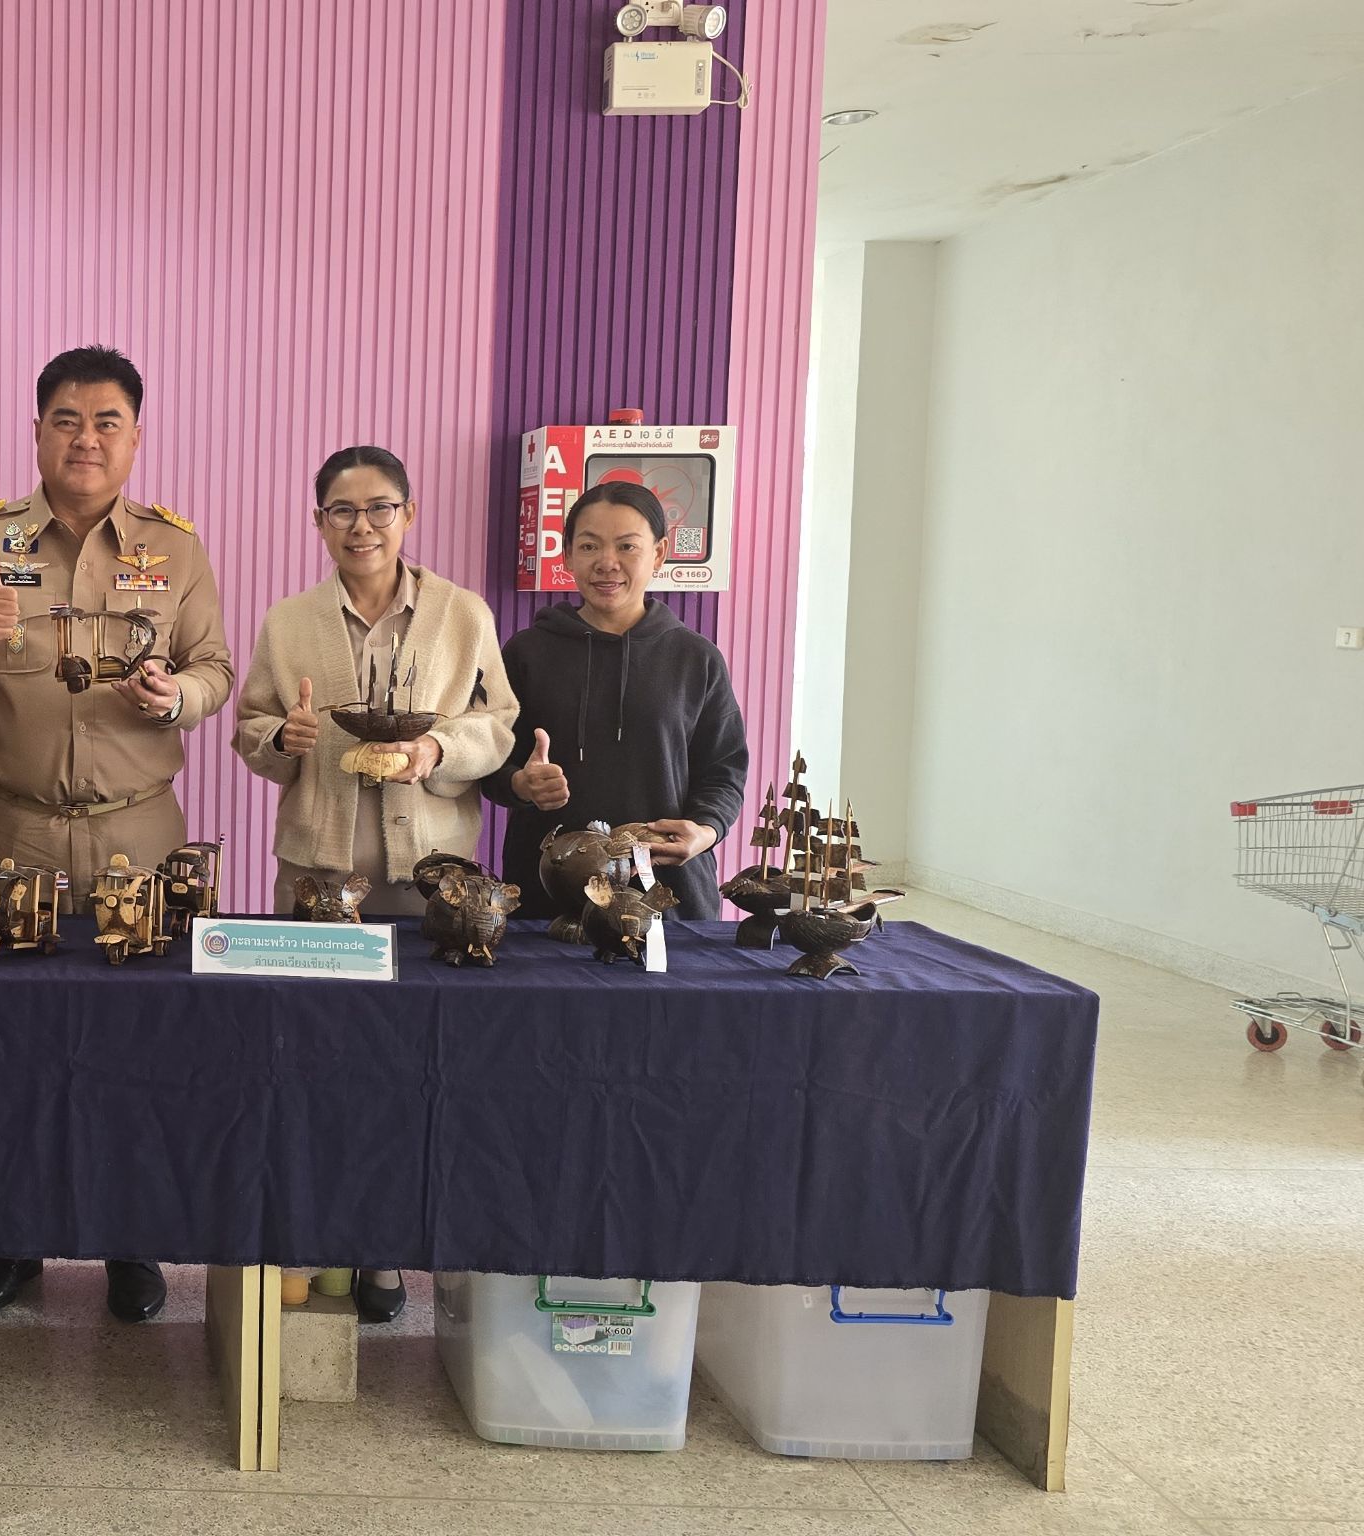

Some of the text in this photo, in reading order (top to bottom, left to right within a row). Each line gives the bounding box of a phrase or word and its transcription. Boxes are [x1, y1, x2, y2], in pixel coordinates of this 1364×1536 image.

[686, 570, 707, 579] 1669
[231, 935, 365, 950] กะลามะพร้าว Handmade
[254, 956, 341, 973] อำเภอเวียงเชียงรุ้ง
